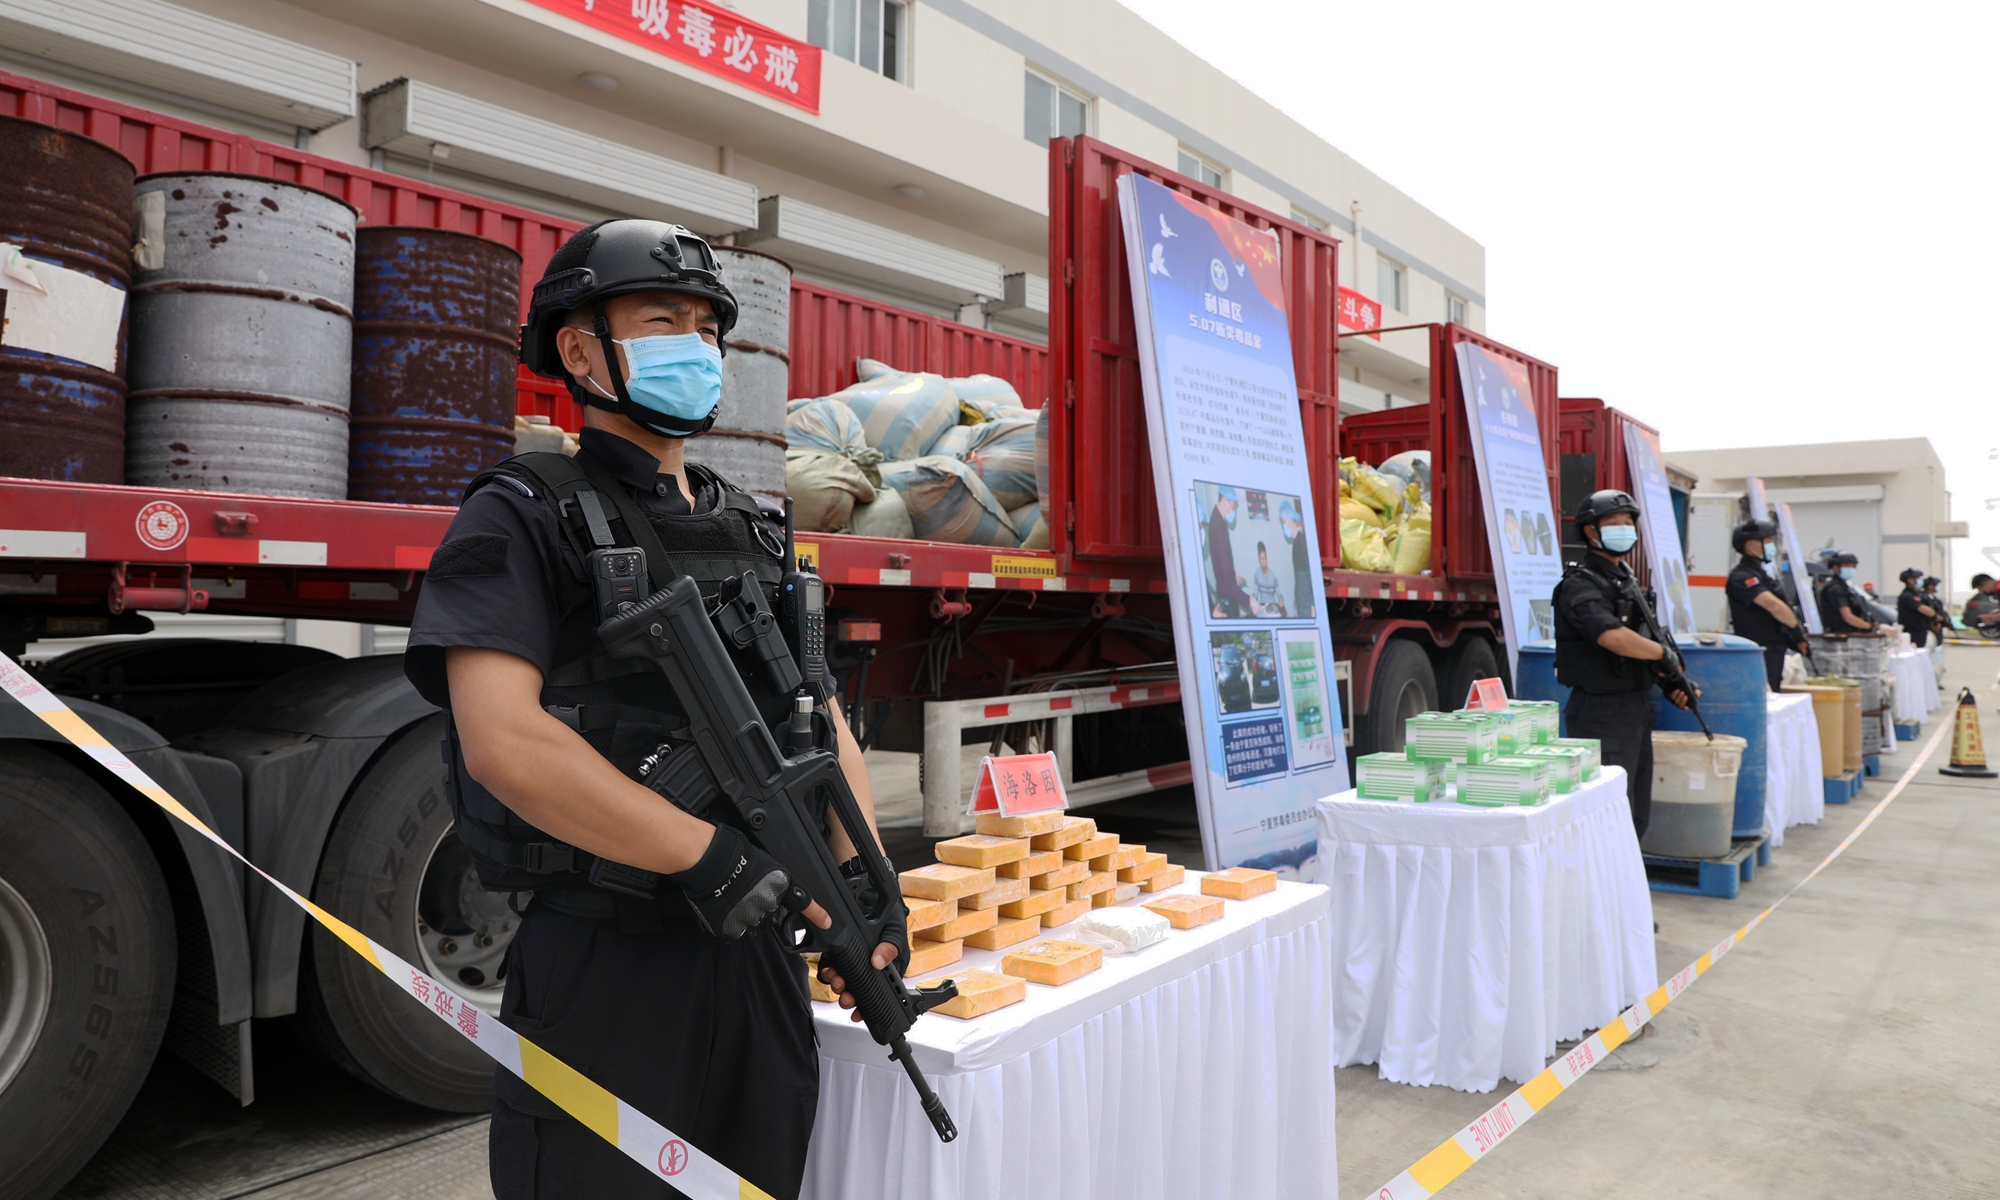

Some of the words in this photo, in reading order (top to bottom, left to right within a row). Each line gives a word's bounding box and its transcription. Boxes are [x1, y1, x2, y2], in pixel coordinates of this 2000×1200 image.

[631, 0, 799, 95] 吸毒必戒
[1204, 292, 1243, 324] 利通区
[1189, 313, 1262, 351] 5.07贩卖毒品案
[1003, 768, 1056, 800] 海洛因
[714, 855, 748, 898] POLICE
[411, 969, 479, 1039] 警戒线
[1469, 1116, 1497, 1153] LINE
[1489, 1101, 1517, 1138] LIMIT
